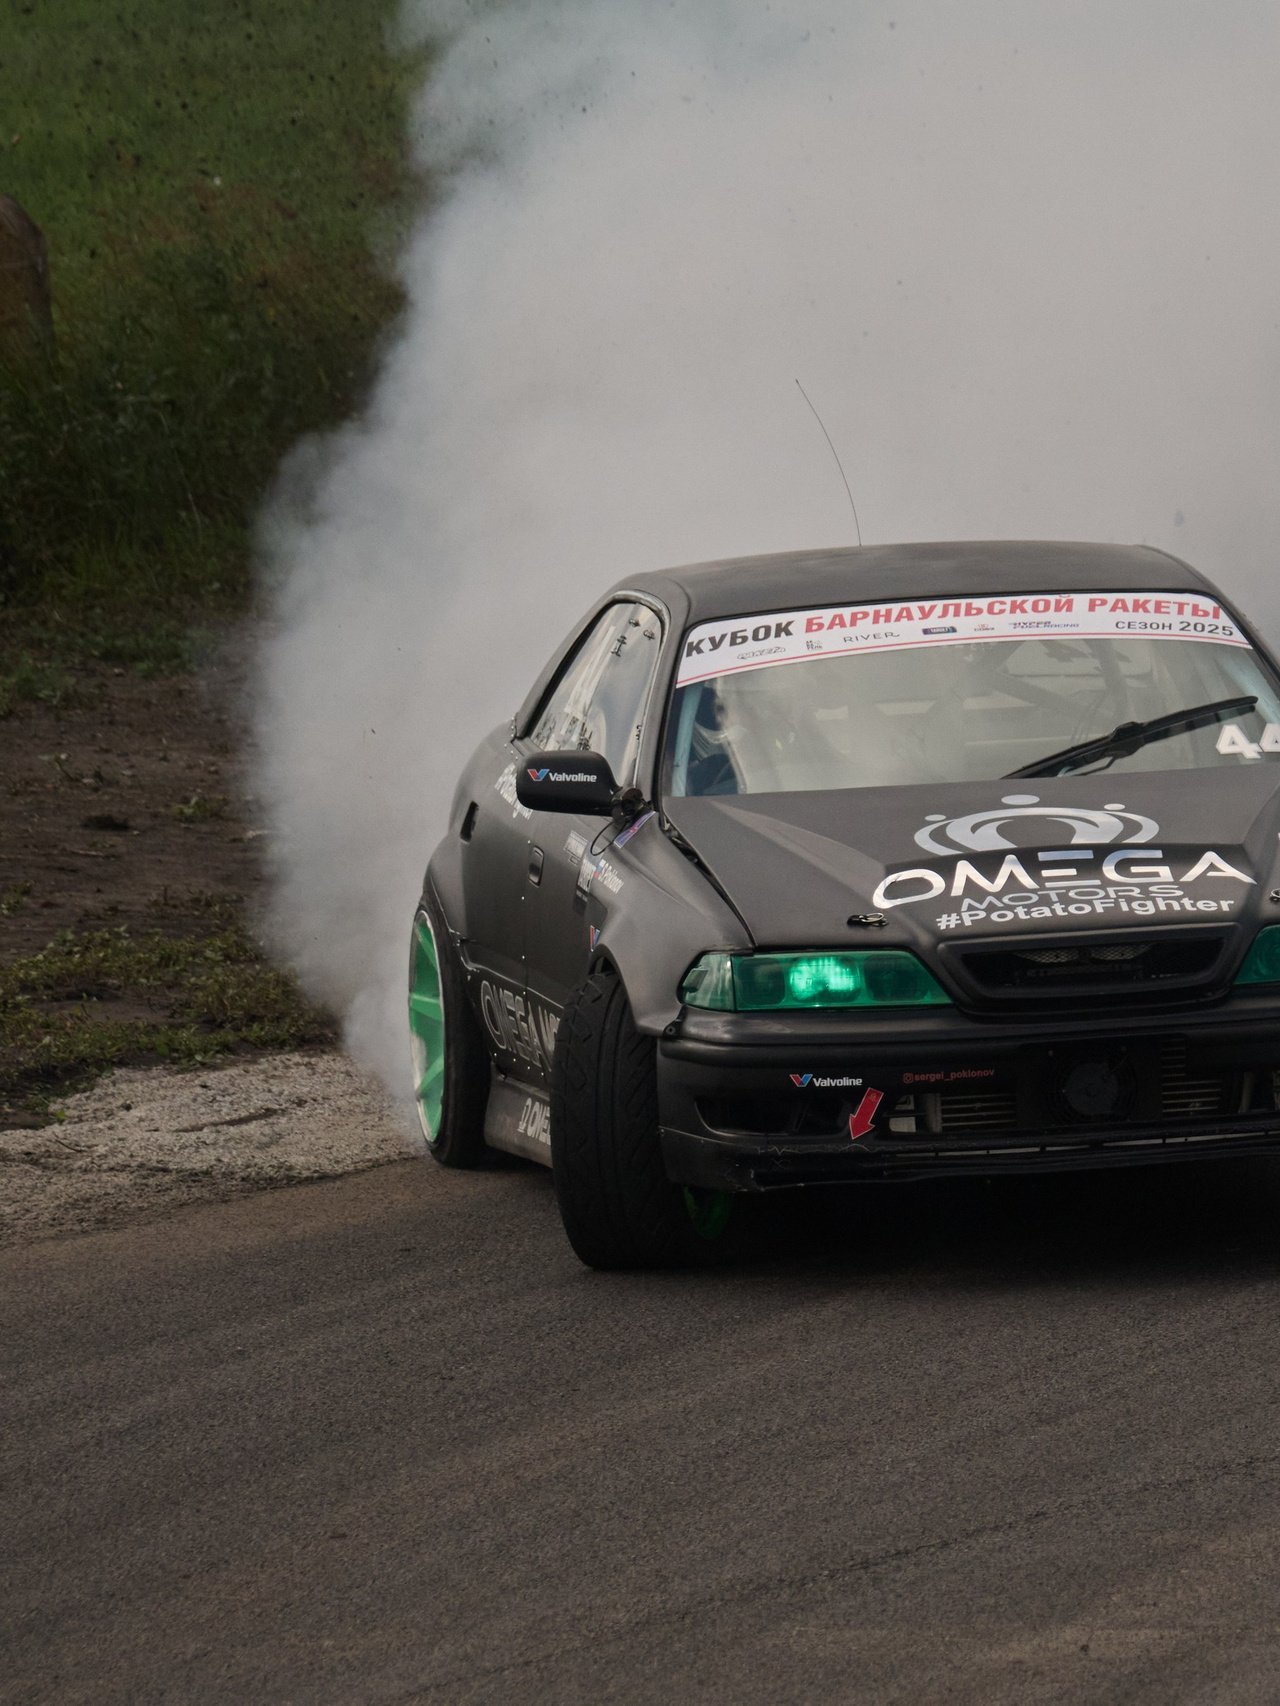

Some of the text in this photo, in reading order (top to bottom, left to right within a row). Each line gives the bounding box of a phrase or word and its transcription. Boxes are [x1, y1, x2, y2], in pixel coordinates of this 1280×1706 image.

[685, 595, 1221, 658] КУБОК БАРНАУЛЬСКОЙ РАКЕТЫ
[1115, 620, 1235, 637] СЕЗОН 2025
[548, 772, 598, 783] Valvoline
[872, 849, 1258, 910] OMEGA
[960, 884, 1187, 912] MOTORS
[935, 896, 1236, 930] #PotatoFighter
[813, 1077, 863, 1087] Valvoline
[914, 1069, 995, 1082] sergei_poklonov
